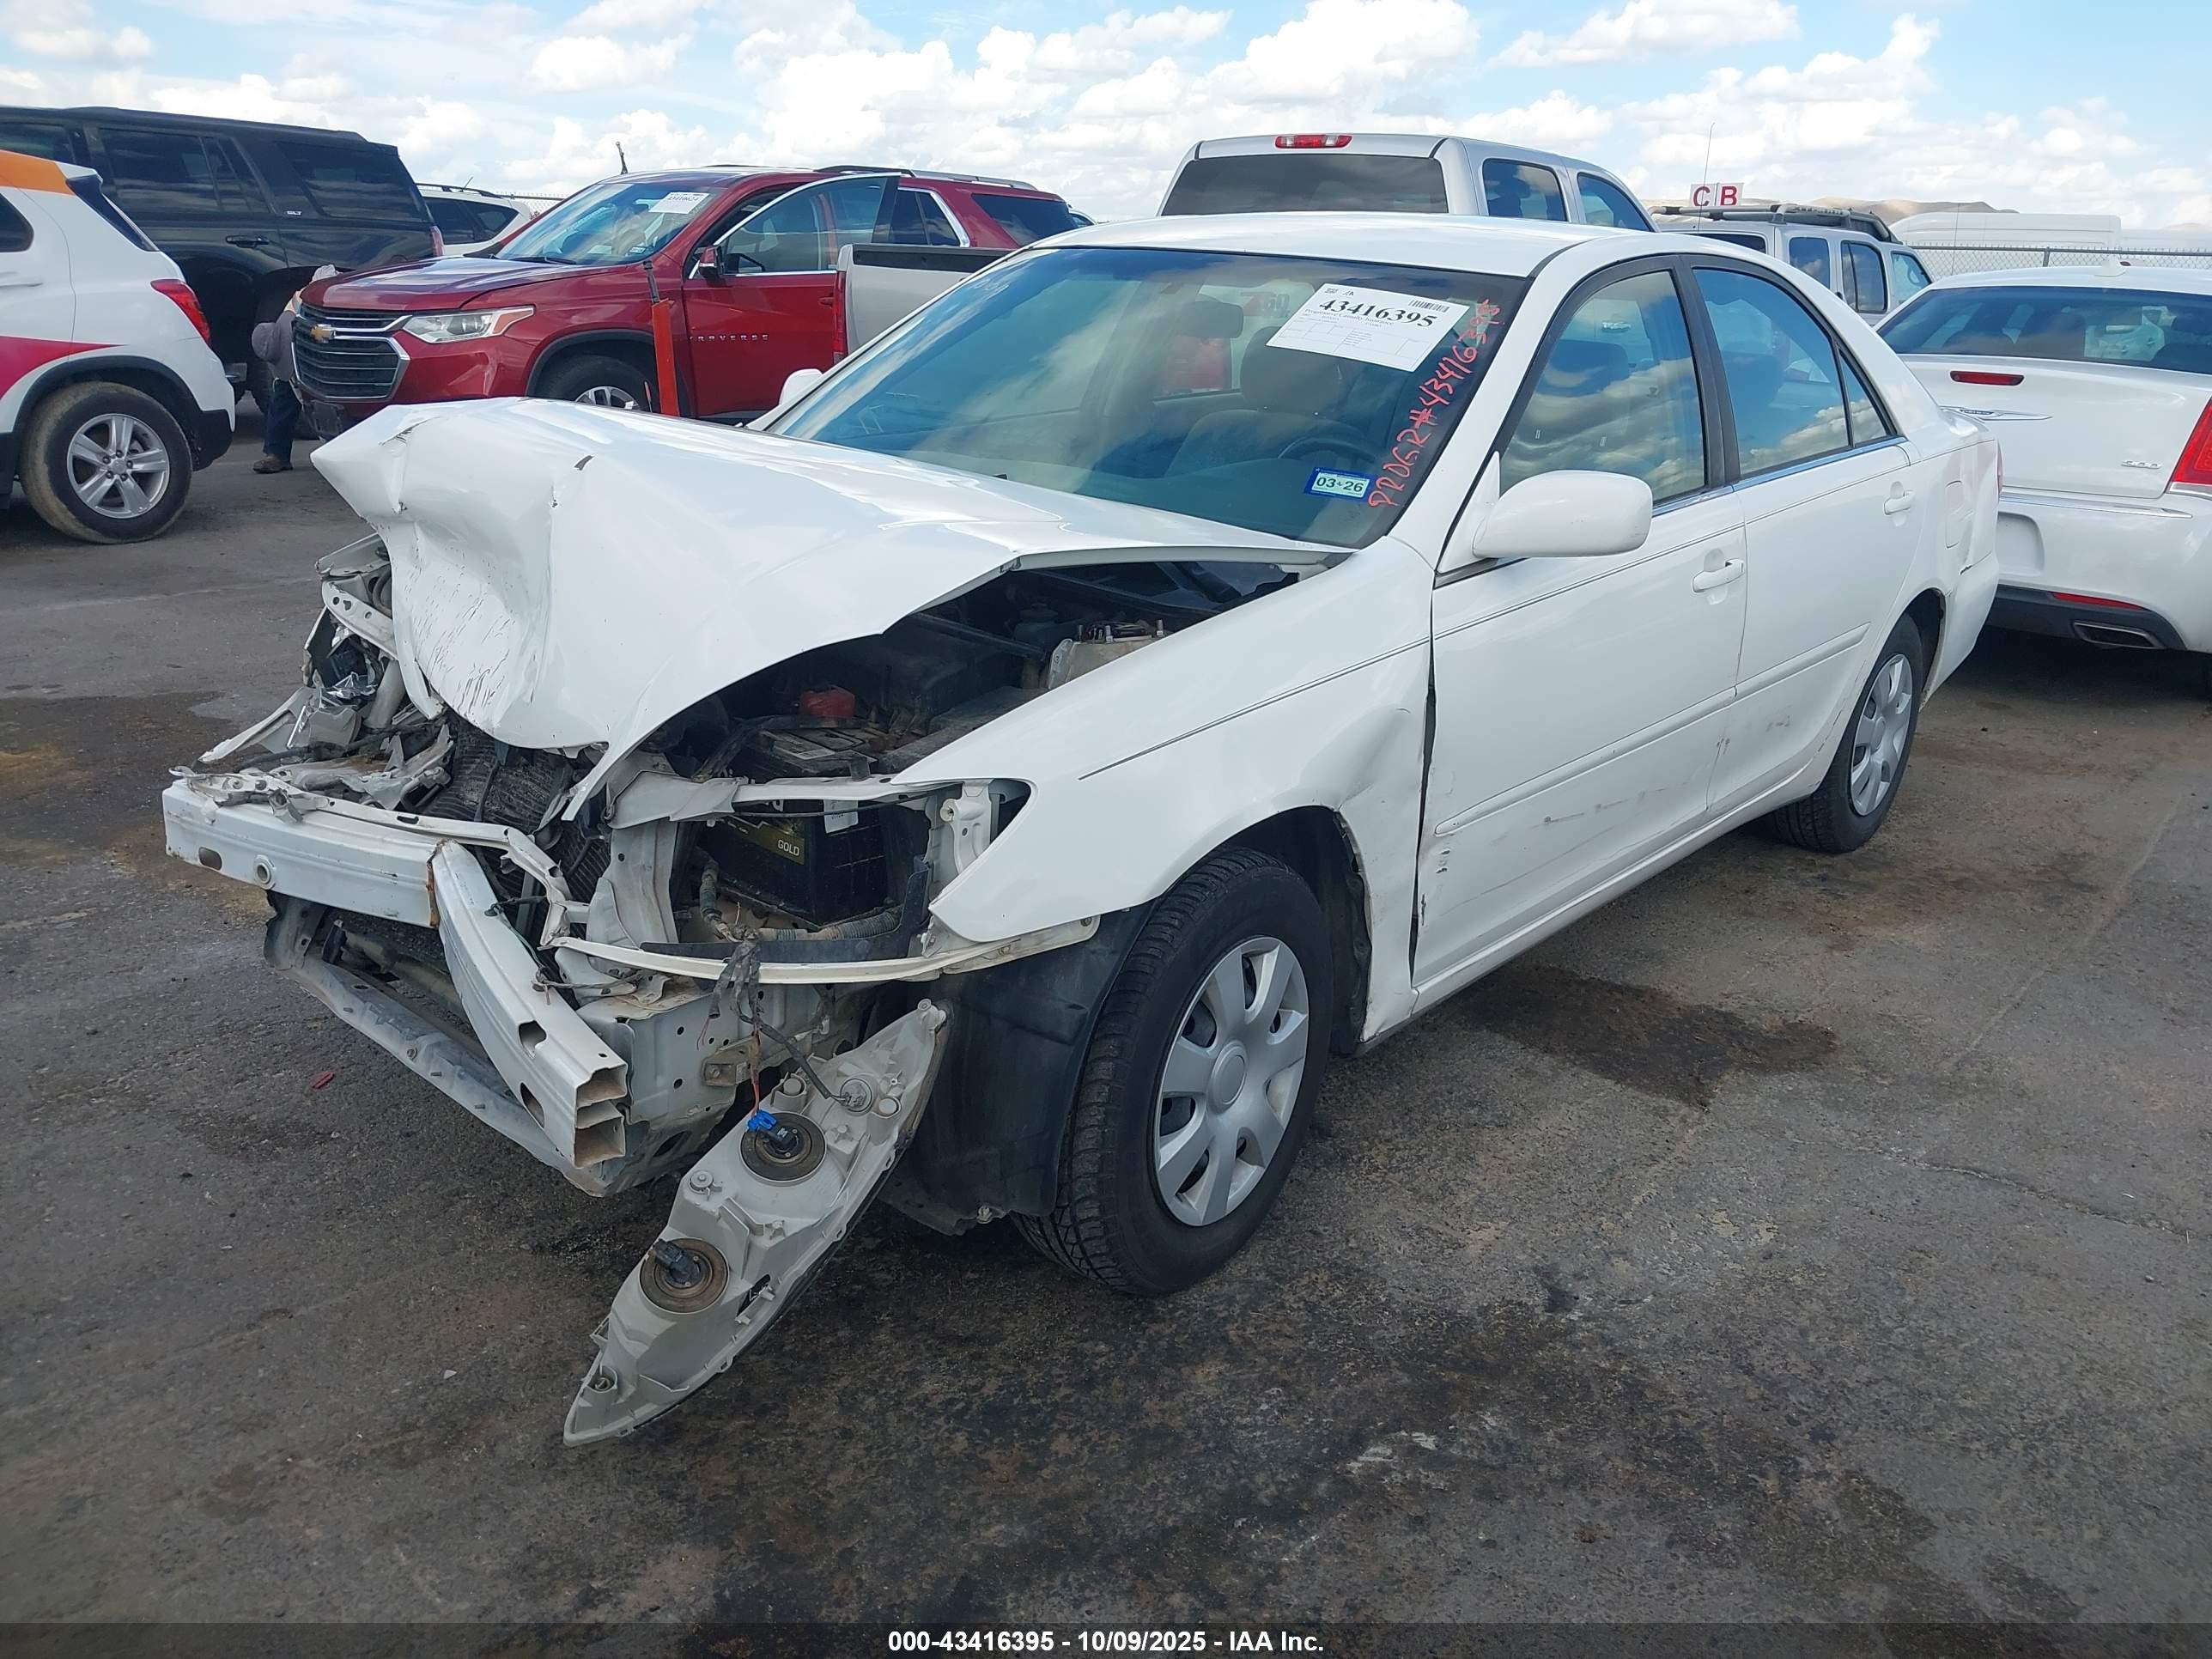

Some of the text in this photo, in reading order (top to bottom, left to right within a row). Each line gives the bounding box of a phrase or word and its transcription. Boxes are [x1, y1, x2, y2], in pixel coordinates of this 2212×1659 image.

[1693, 185, 1711, 206] C
[1720, 185, 1737, 206] B
[1319, 300, 1437, 327] 43416395
[777, 839, 800, 856] GOLD
